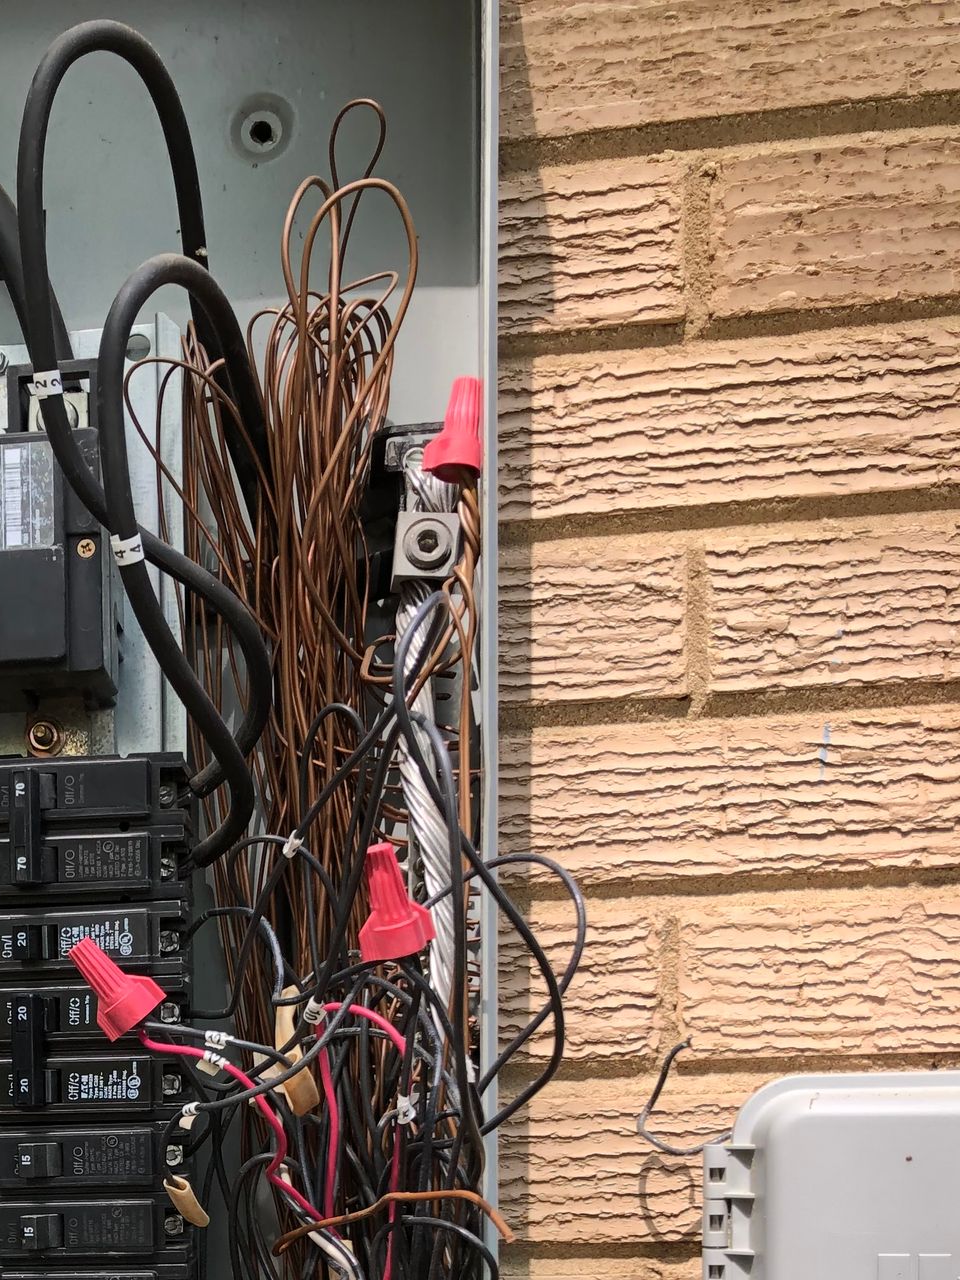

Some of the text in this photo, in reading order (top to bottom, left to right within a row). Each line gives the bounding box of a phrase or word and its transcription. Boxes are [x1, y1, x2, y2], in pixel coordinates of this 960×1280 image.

[35, 379, 48, 390] 2
[114, 549, 126, 559] 4
[16, 783, 25, 796] 70
[17, 856, 27, 870] 70
[17, 932, 27, 947] 20
[18, 1006, 27, 1020] 20
[20, 1078, 29, 1092] 20
[22, 1155, 31, 1165] 15
[24, 1226, 33, 1237] 15
